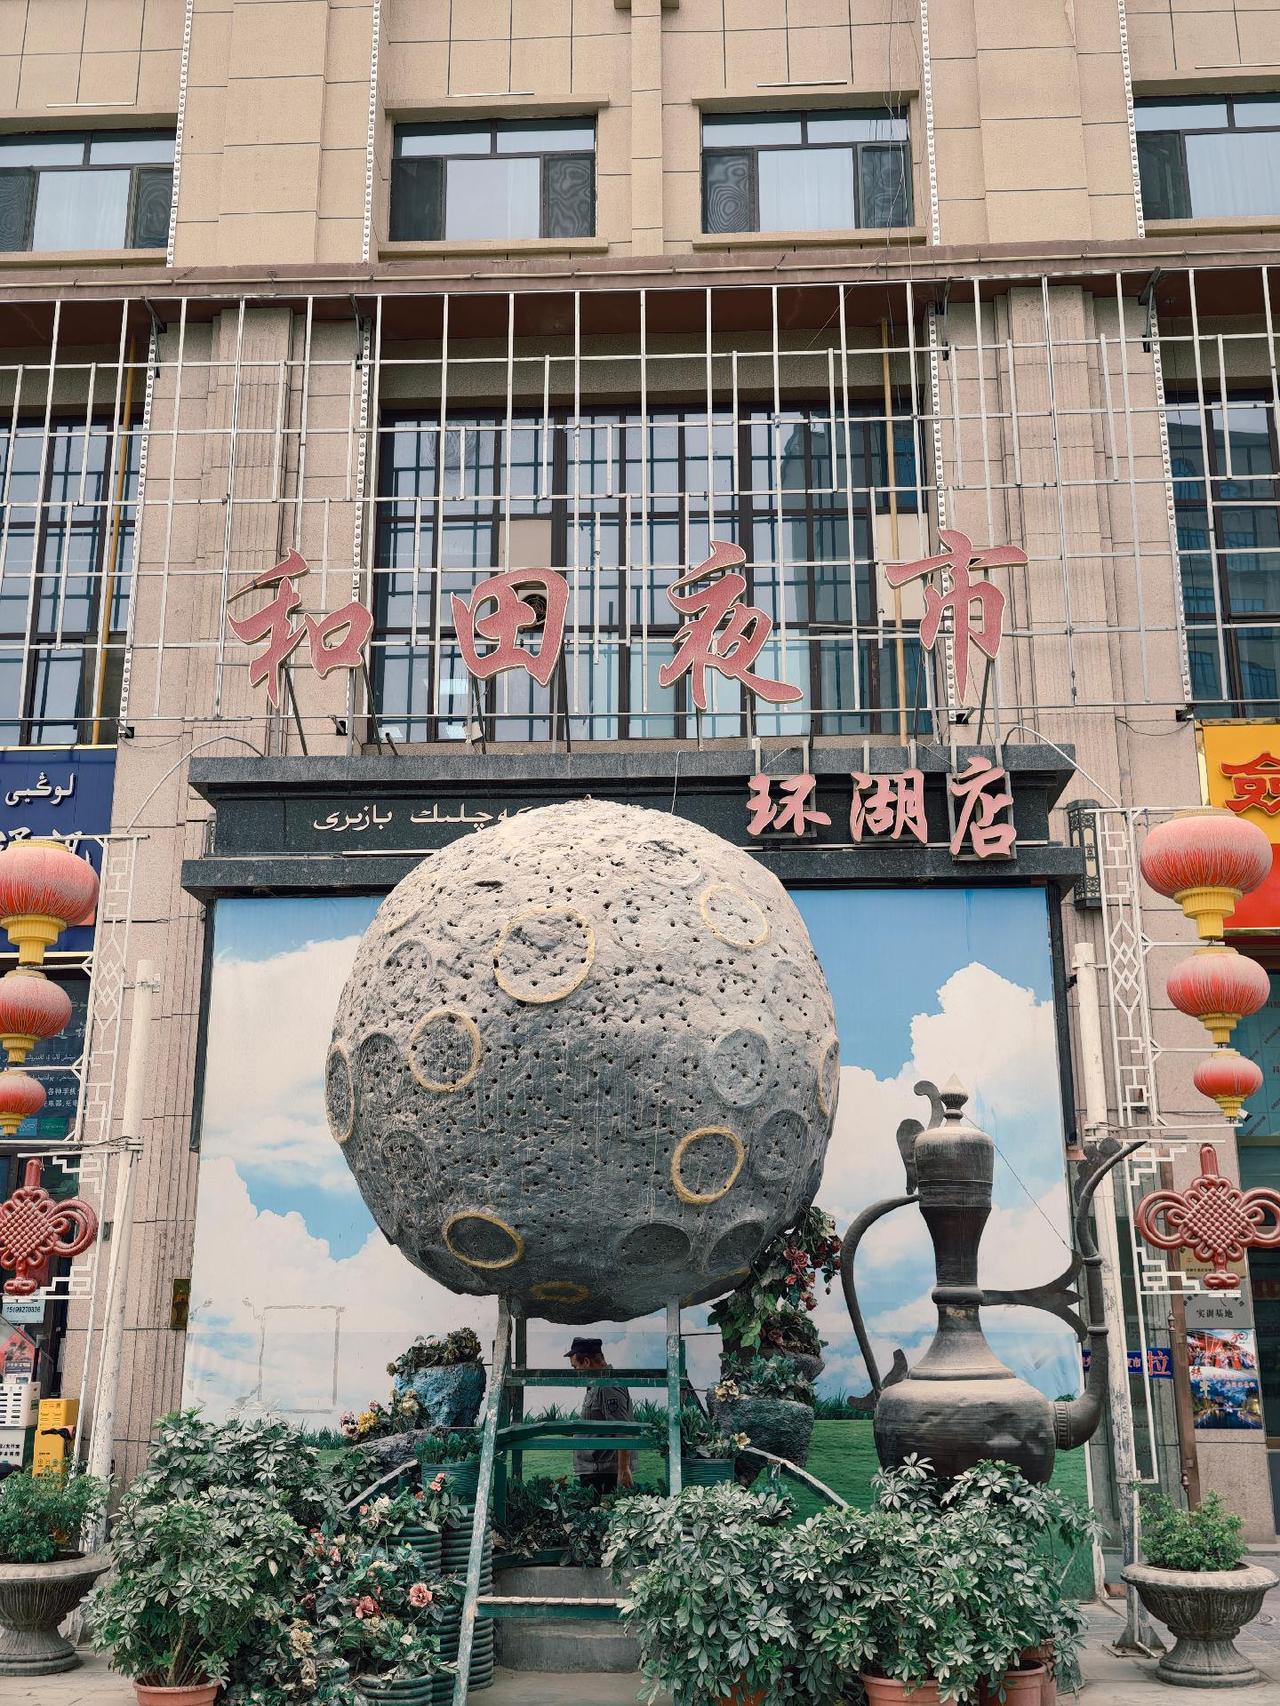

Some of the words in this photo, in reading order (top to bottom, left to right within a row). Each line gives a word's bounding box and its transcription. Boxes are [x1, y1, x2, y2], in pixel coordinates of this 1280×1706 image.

[226, 529, 1030, 710] 和田夜市
[746, 755, 1017, 858] 环湖店
